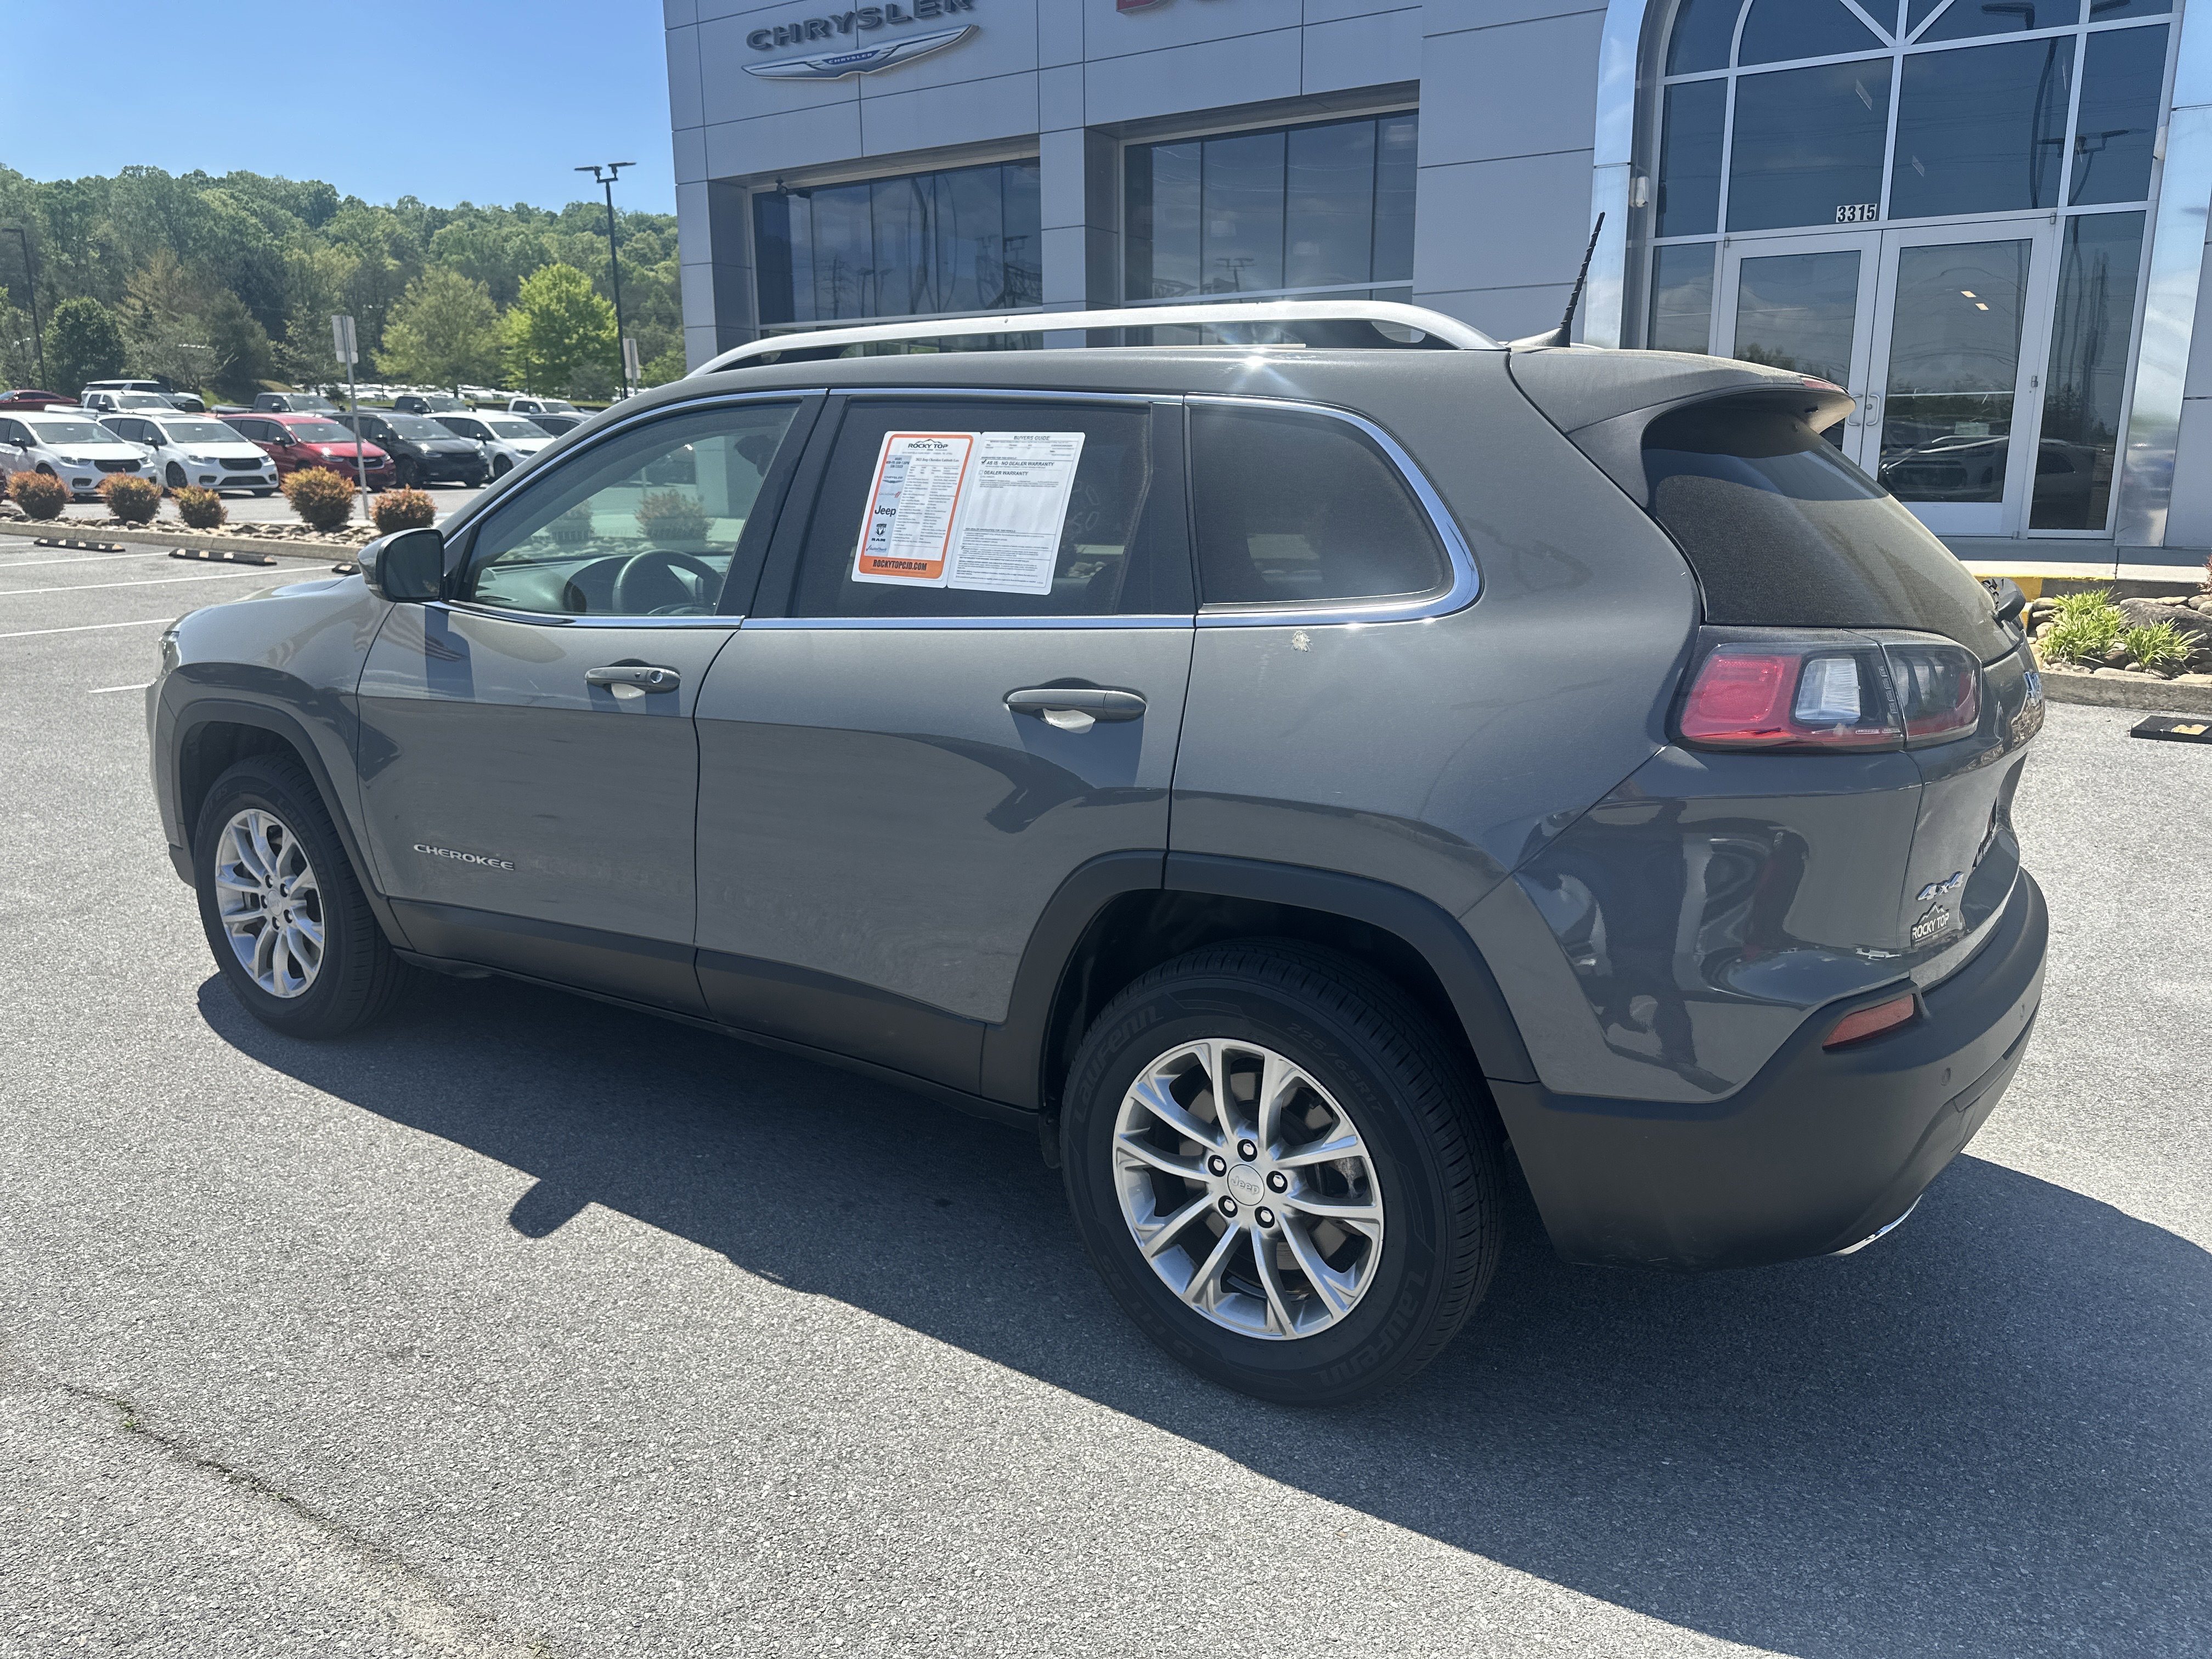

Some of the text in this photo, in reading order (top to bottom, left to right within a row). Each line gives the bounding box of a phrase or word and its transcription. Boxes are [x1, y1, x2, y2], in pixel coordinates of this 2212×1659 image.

[828, 53, 872, 64] CHRYSLER
[1838, 204, 1875, 222] 3315
[874, 505, 896, 517] Jeep
[873, 560, 927, 571] ROCKYTOPCJD.COM
[414, 844, 515, 871] CHEROKEE
[1912, 919, 1937, 940] ROCKY
[1937, 912, 1949, 929] TOP
[1287, 1023, 1386, 1114] 225/65R17
[1231, 1175, 1260, 1195] Jeep
